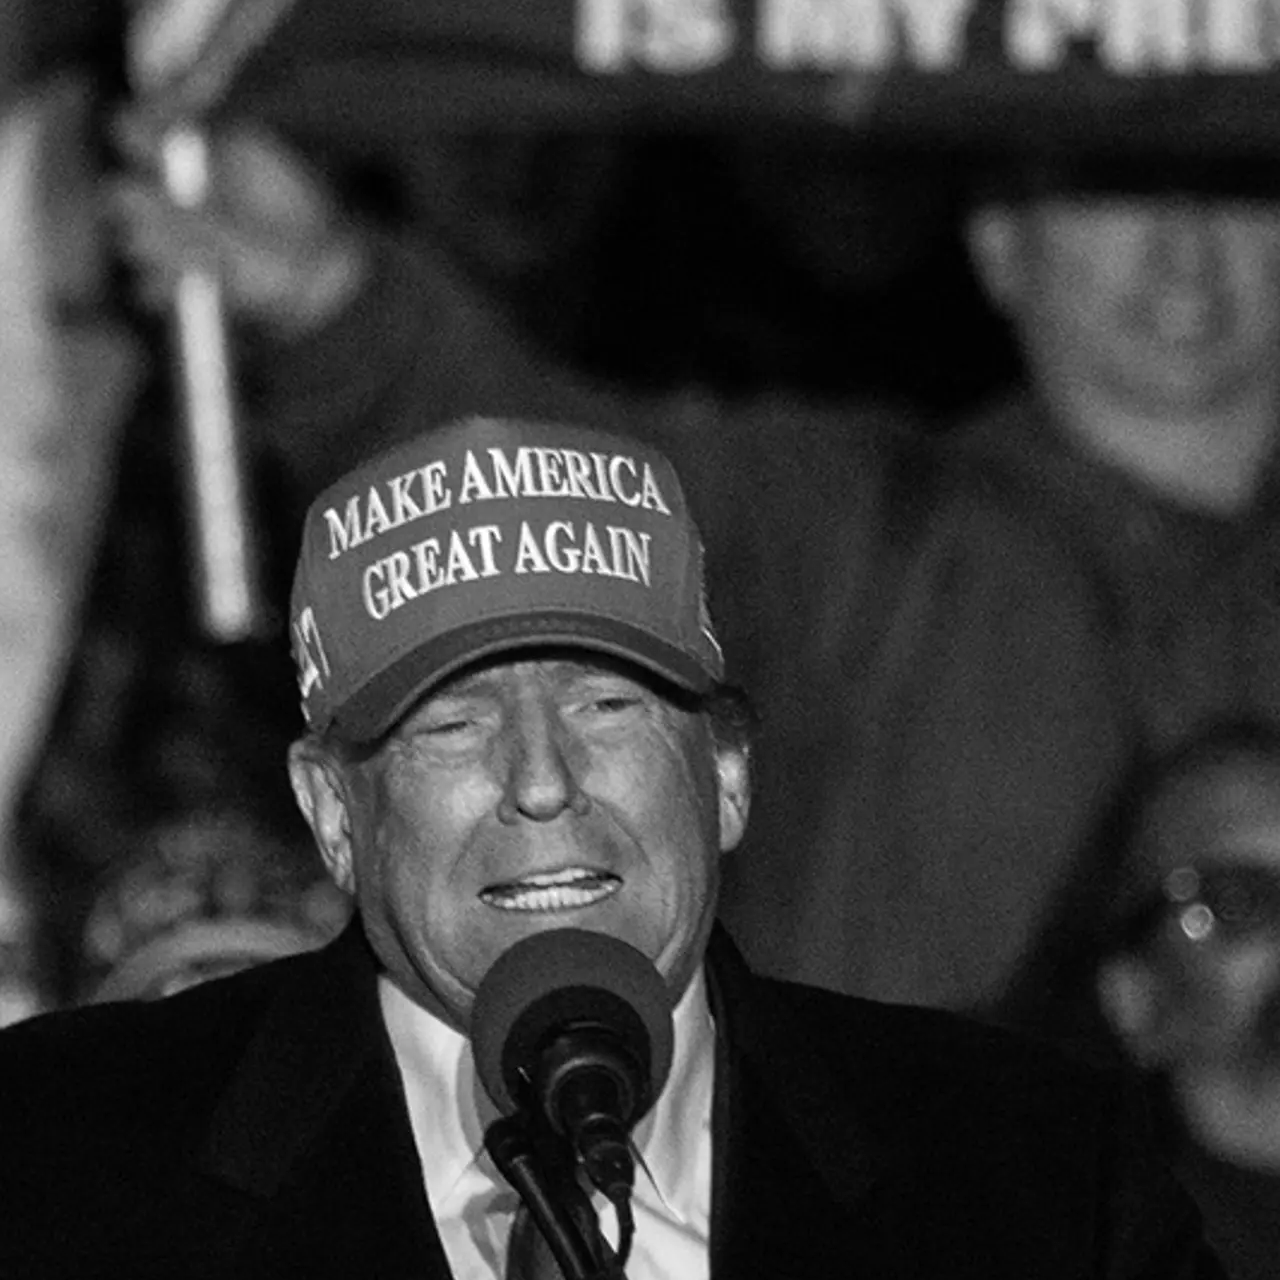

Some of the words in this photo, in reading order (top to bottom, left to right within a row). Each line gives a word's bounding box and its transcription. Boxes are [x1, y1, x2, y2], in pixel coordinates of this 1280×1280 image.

[323, 461, 452, 560] MAKE
[458, 446, 671, 516] AMERICA
[362, 524, 503, 620] GREAT
[515, 521, 651, 586] AGAIN
